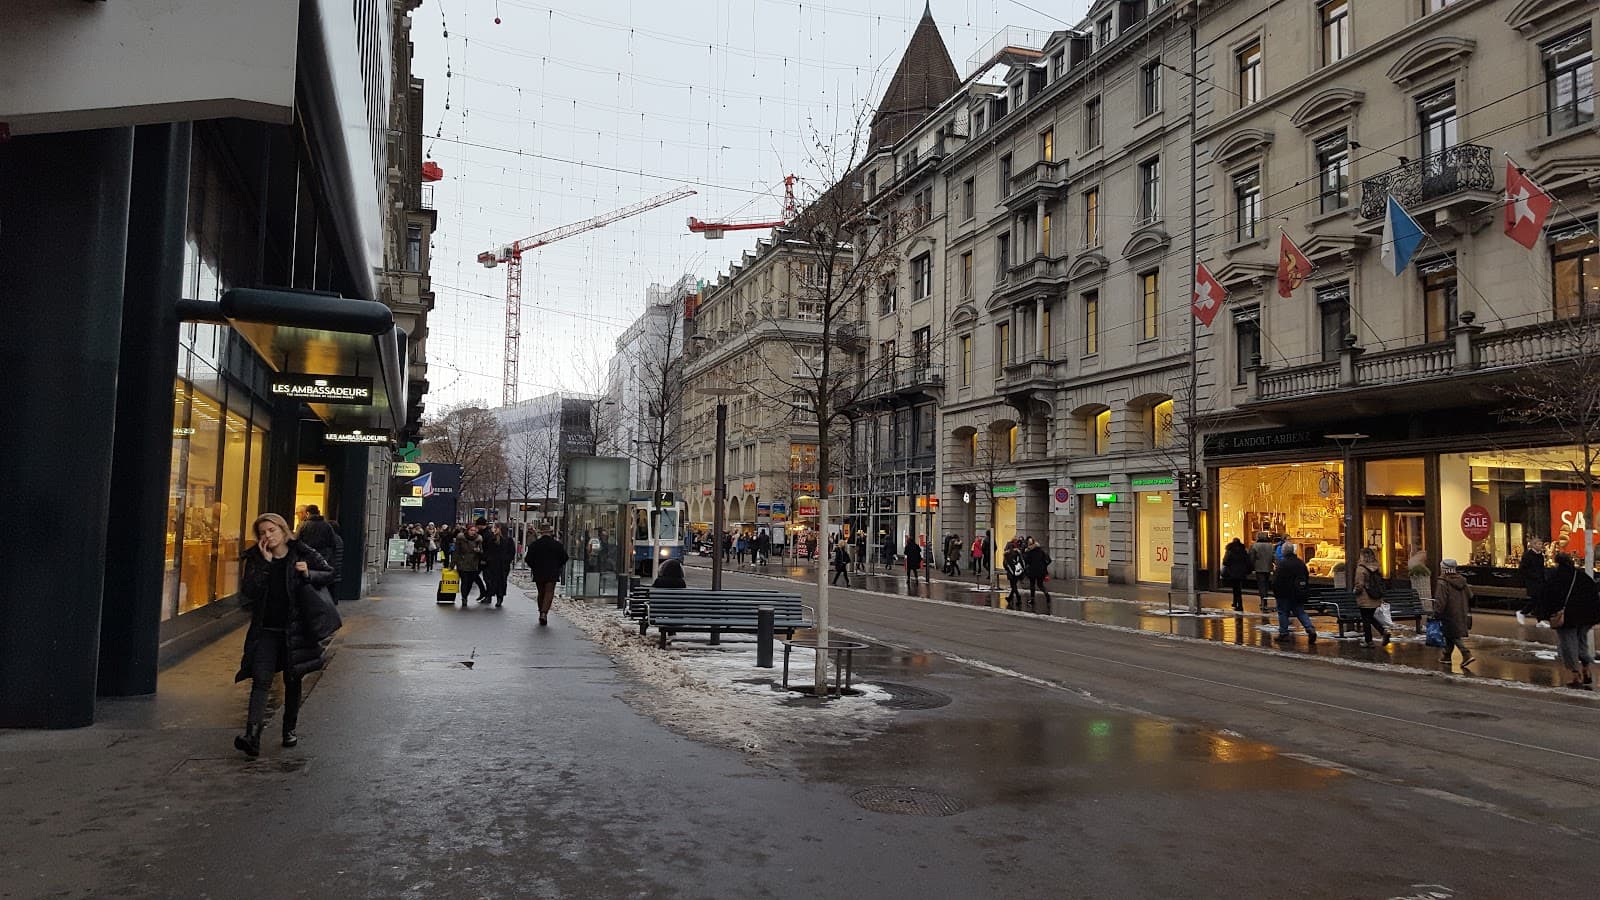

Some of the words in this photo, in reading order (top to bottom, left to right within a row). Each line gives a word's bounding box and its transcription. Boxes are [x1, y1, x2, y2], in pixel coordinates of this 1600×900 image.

[272, 383, 290, 393] LES
[291, 385, 368, 397] AMBASSADEURS
[338, 433, 387, 441] AMBASSADEURS
[1464, 517, 1488, 528] SALE
[1095, 544, 1105, 558] 70
[1156, 546, 1168, 562] 50
